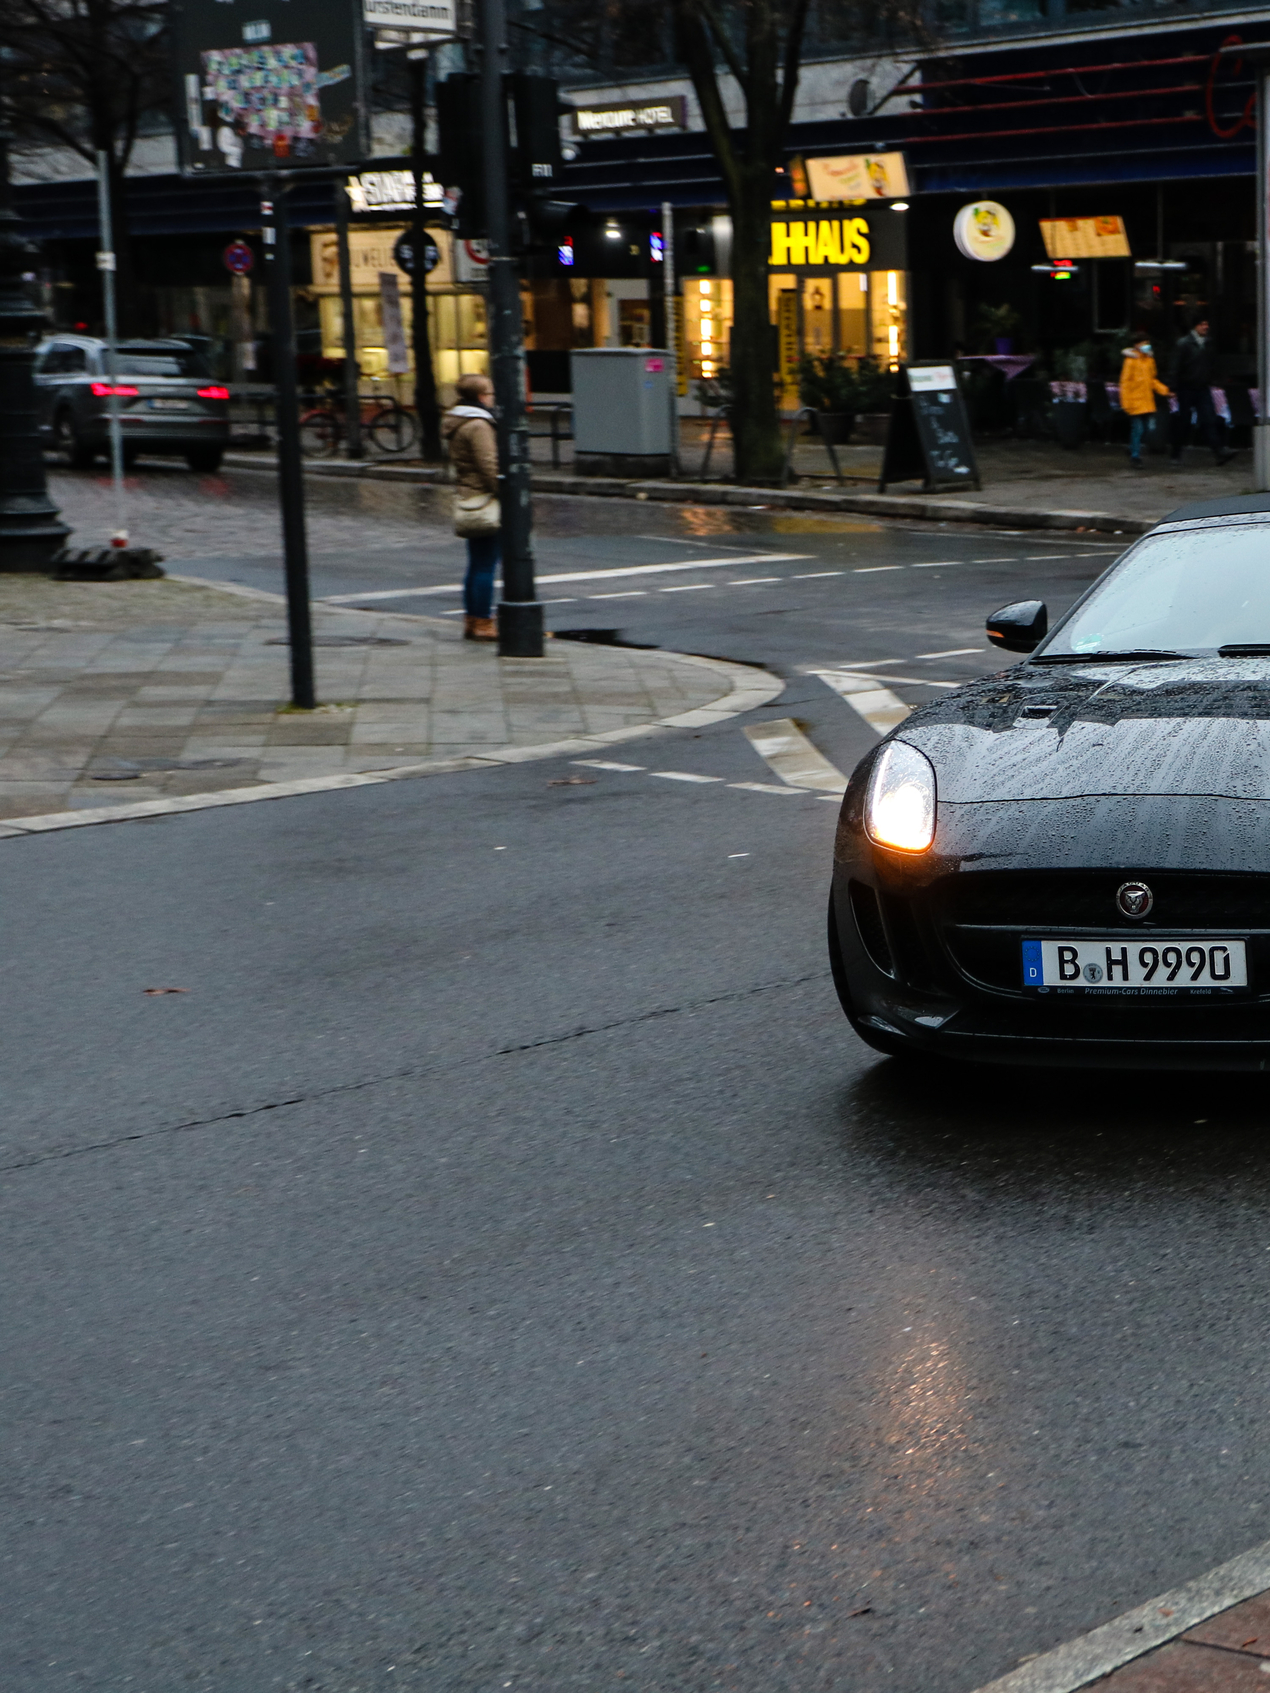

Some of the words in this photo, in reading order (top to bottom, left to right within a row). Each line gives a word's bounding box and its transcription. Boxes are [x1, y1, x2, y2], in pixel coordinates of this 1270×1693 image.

[1057, 945, 1081, 981] B
[1105, 946, 1130, 982] H
[1138, 945, 1231, 982] 9990
[1029, 967, 1037, 978] D
[1057, 987, 1075, 995] Berlin
[1084, 987, 1138, 996] Premium-Cars
[1140, 987, 1179, 996] Dinnebier
[1190, 987, 1212, 995] Krefeld
